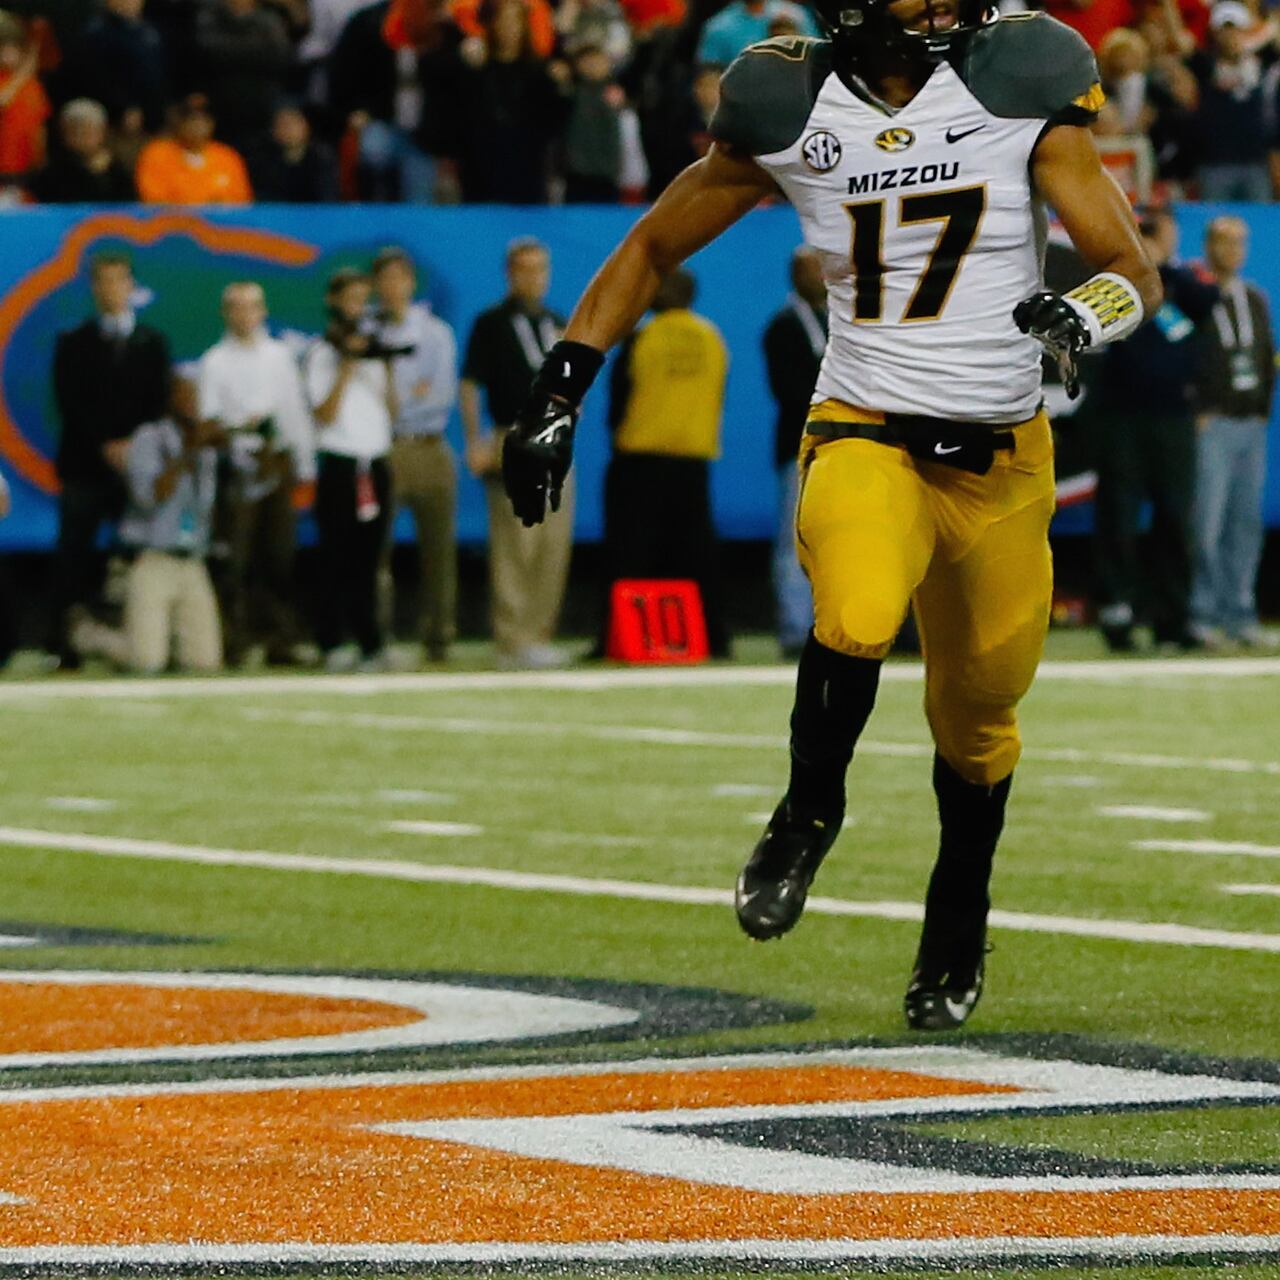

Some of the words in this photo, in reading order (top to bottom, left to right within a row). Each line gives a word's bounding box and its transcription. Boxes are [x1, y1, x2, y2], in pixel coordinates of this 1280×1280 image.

[801, 130, 842, 171] SEC
[848, 161, 960, 195] MIZZOU
[841, 160, 989, 325] 17
[633, 594, 690, 652] 10
